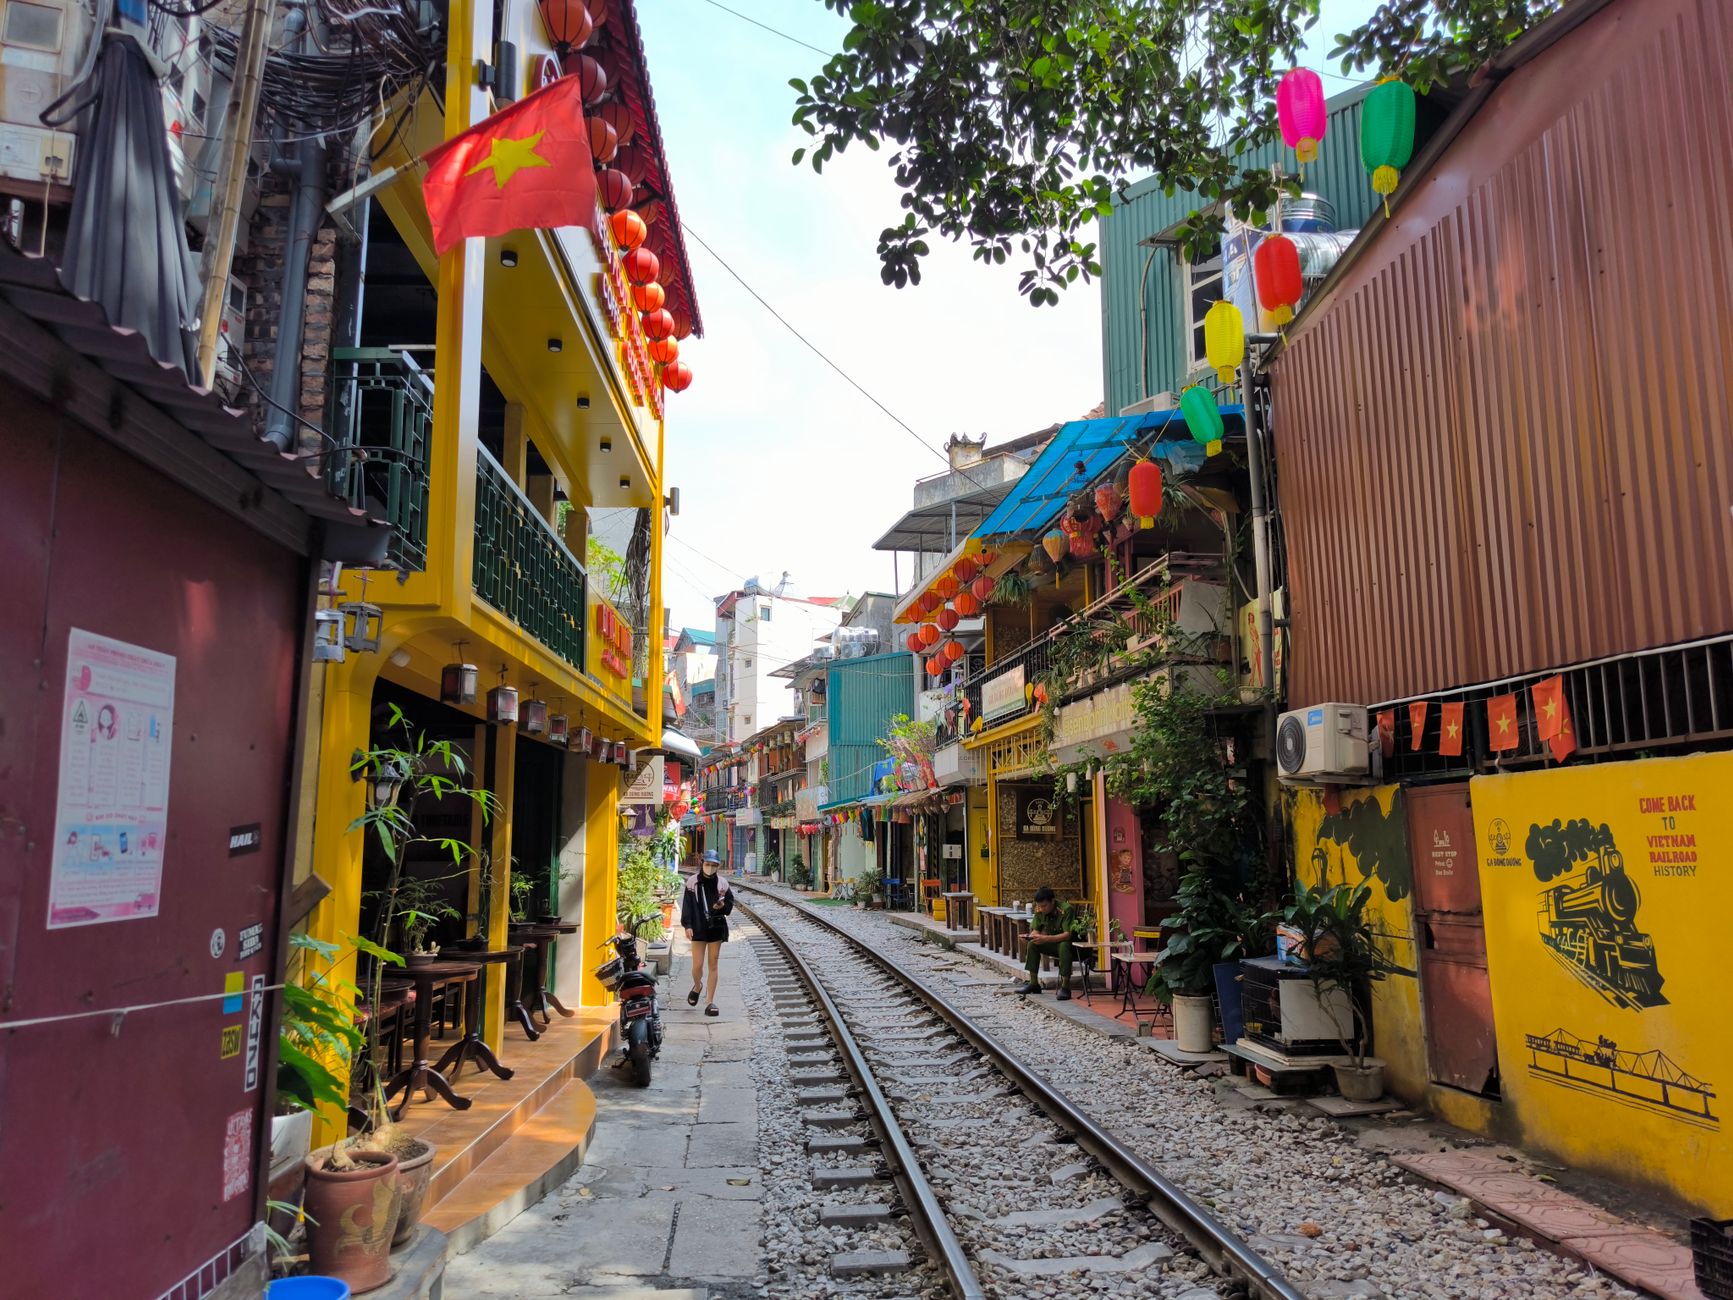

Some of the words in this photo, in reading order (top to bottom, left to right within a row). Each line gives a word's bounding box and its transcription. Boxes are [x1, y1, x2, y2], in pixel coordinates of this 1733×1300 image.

[1639, 797, 1665, 814] COME
[1668, 795, 1696, 812] BACK
[1662, 816, 1676, 830] TO
[230, 832, 253, 848] HAIL
[1646, 834, 1696, 848] VIETNAM
[1649, 851, 1697, 863] RAILROAD
[1654, 865, 1696, 877] HISTORY
